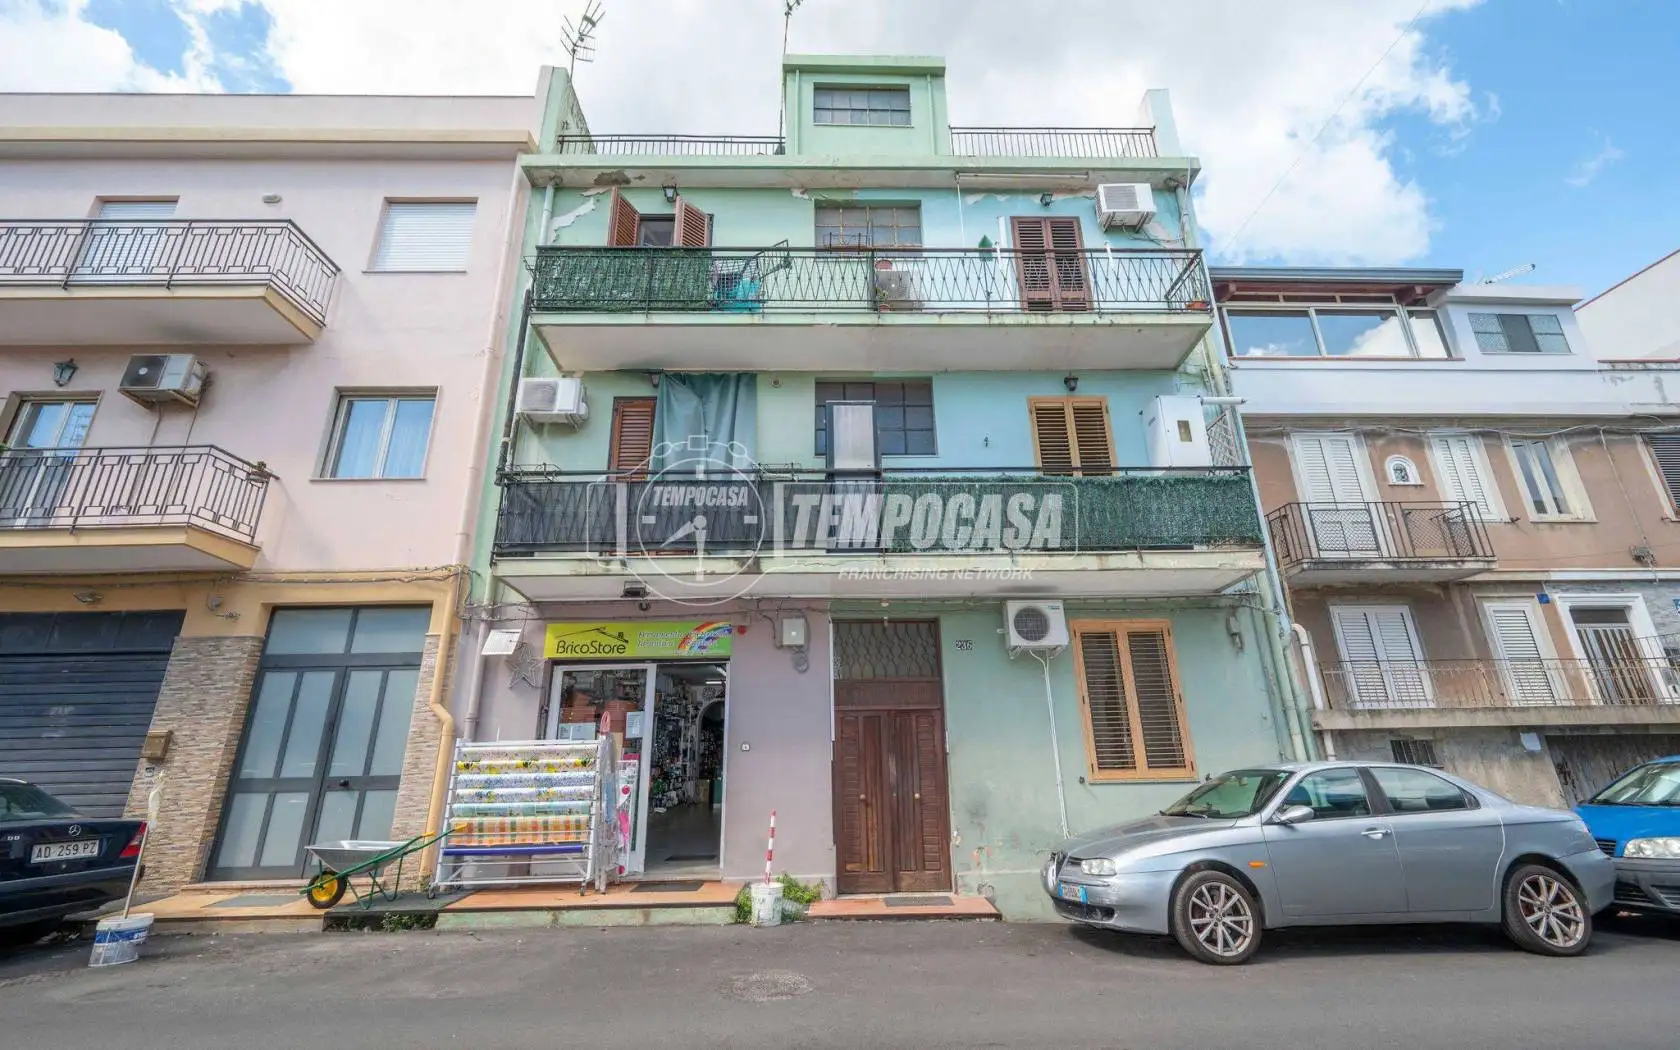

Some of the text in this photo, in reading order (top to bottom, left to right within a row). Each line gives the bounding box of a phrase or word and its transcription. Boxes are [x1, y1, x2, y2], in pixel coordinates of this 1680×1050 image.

[556, 640, 626, 655] BricoStore
[36, 841, 96, 858] AD 259 PZ
